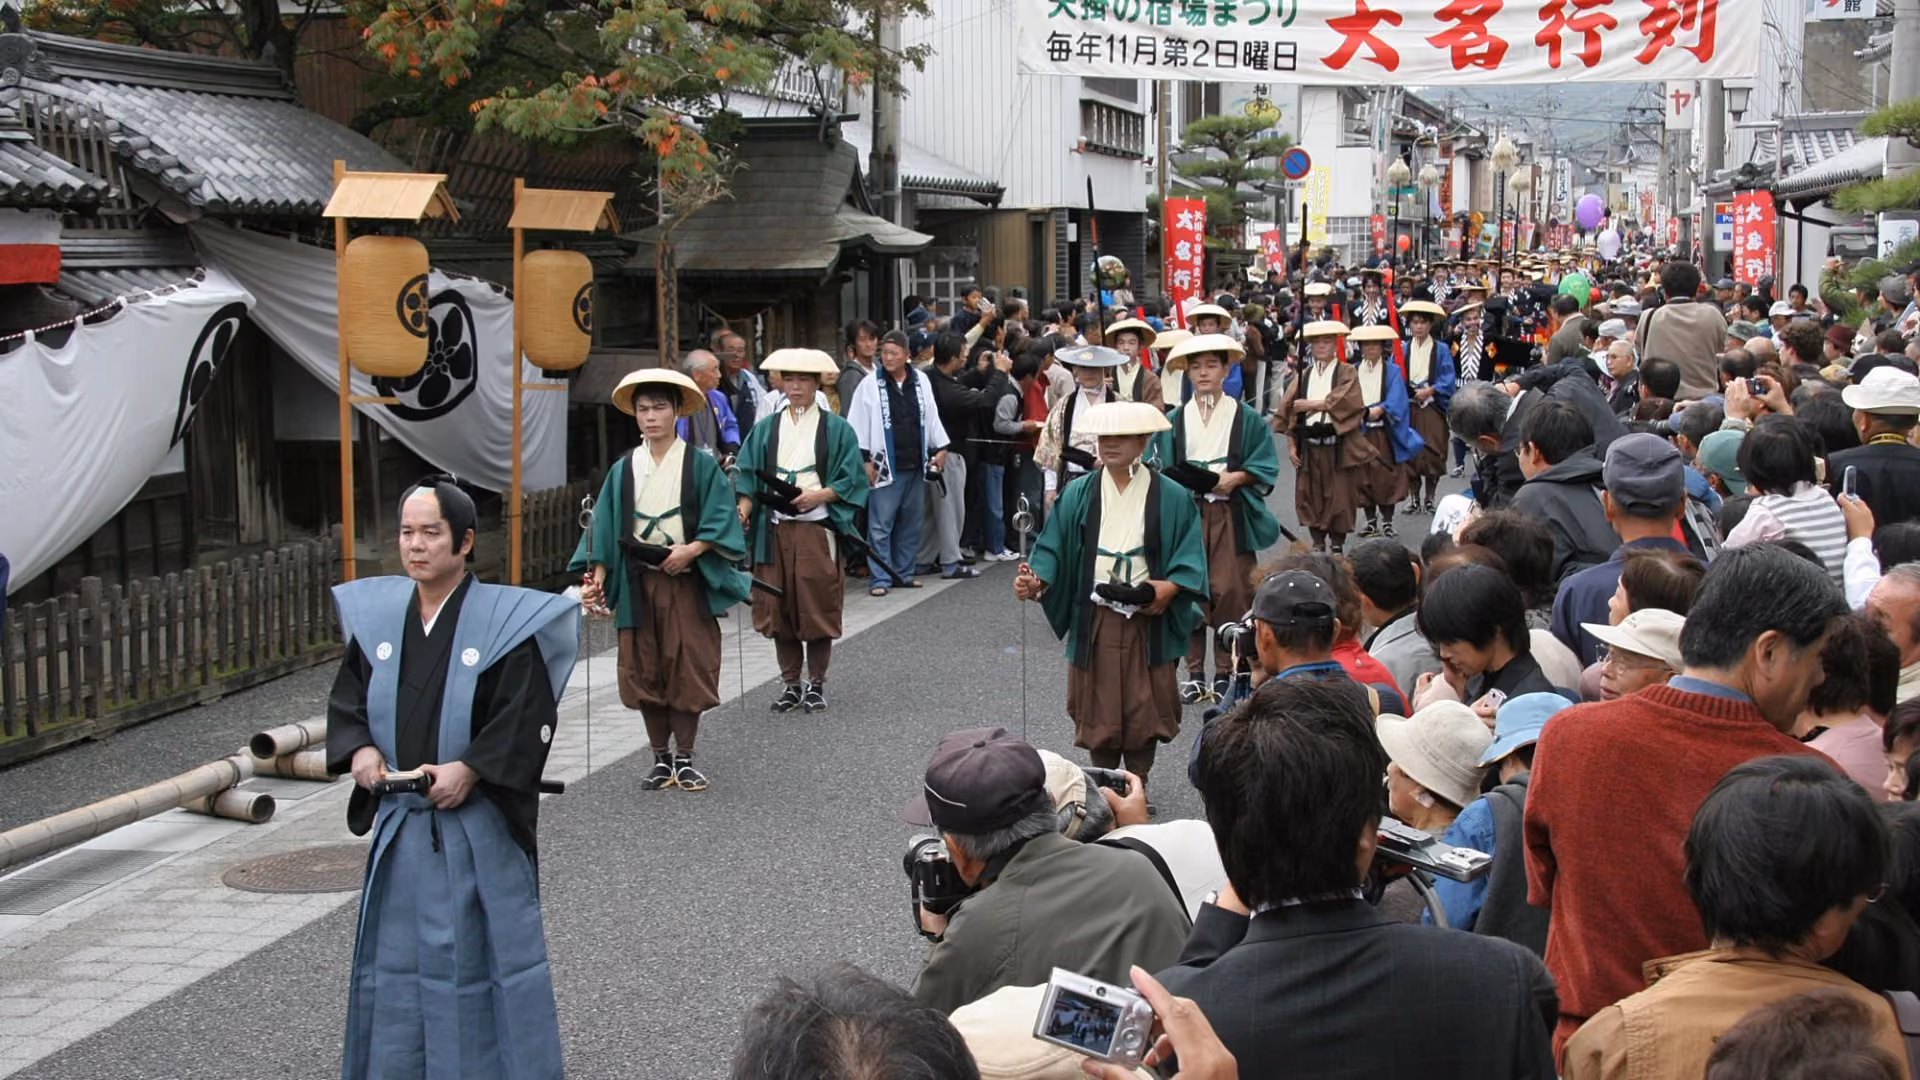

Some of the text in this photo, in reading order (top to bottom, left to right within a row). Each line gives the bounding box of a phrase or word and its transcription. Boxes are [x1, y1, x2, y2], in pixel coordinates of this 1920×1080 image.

[1047, 30, 1297, 71] 毎年11月第2日曜日
[1319, 0, 1718, 72] 大名行列
